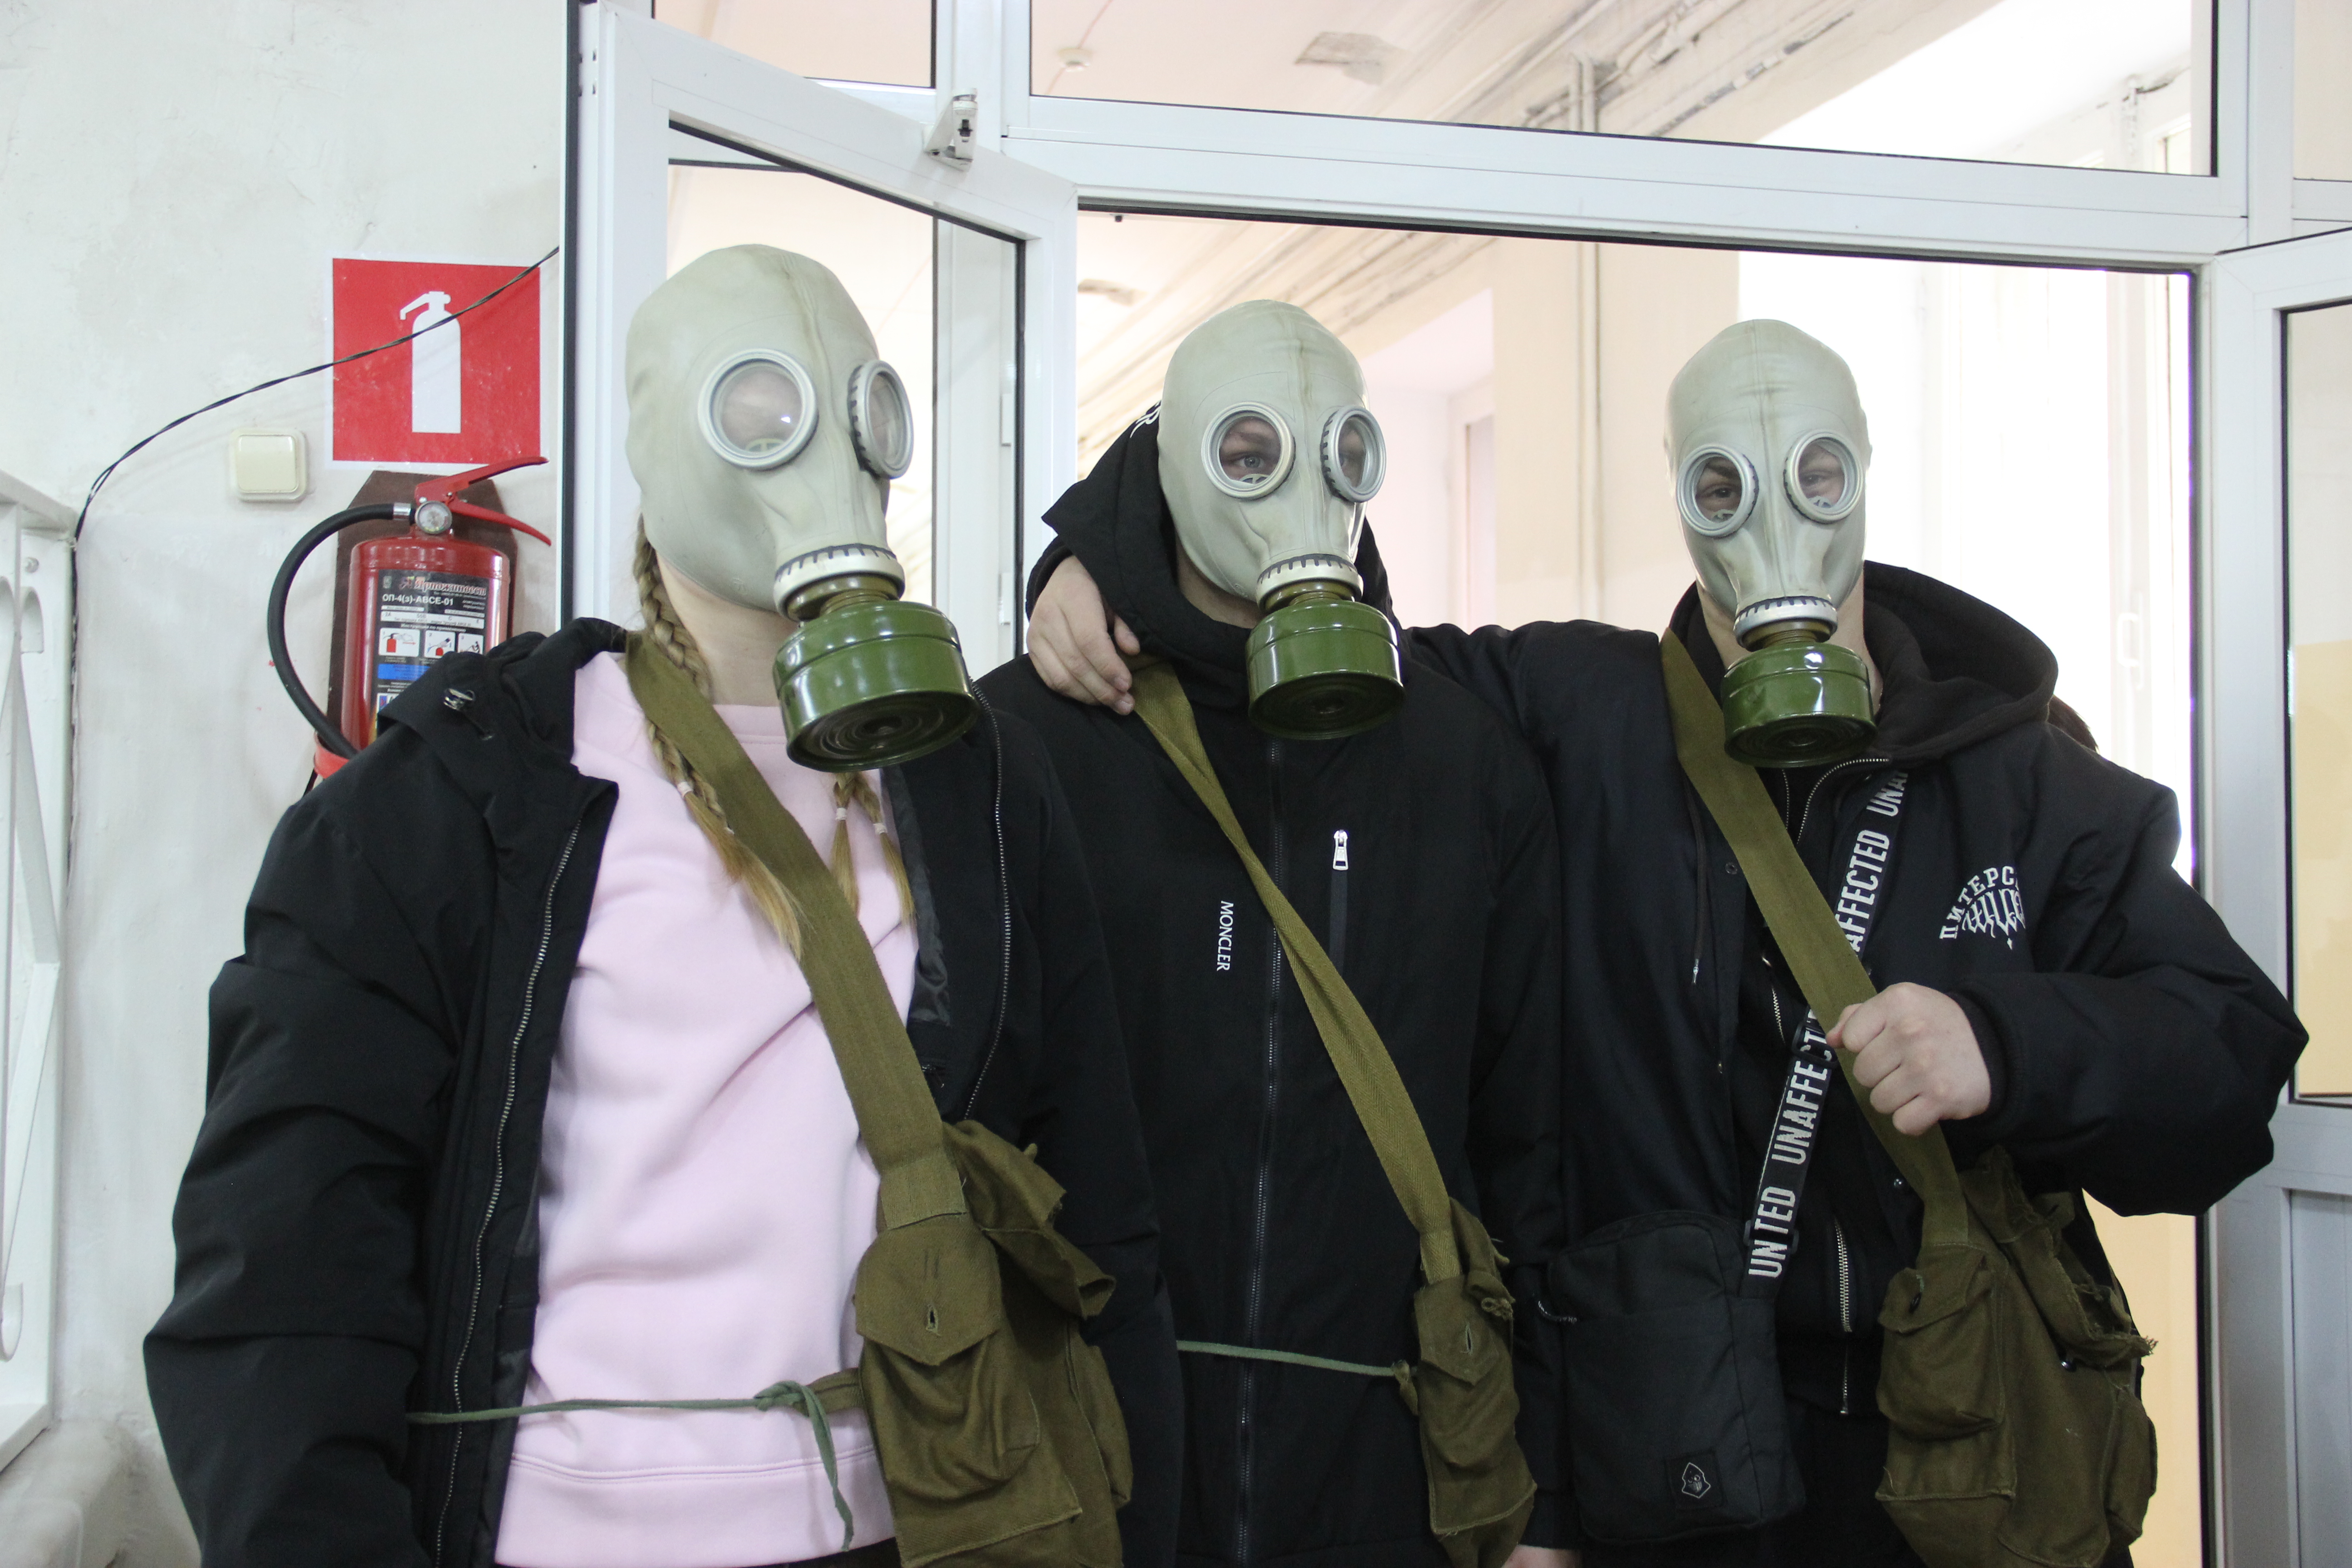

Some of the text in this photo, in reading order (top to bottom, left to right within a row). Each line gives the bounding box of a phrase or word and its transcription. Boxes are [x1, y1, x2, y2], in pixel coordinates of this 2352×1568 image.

[1216, 901, 1234, 971] MONCLER
[1939, 866, 2019, 939] ПИТЕРС
[1749, 1186, 1796, 1278] UNTED
